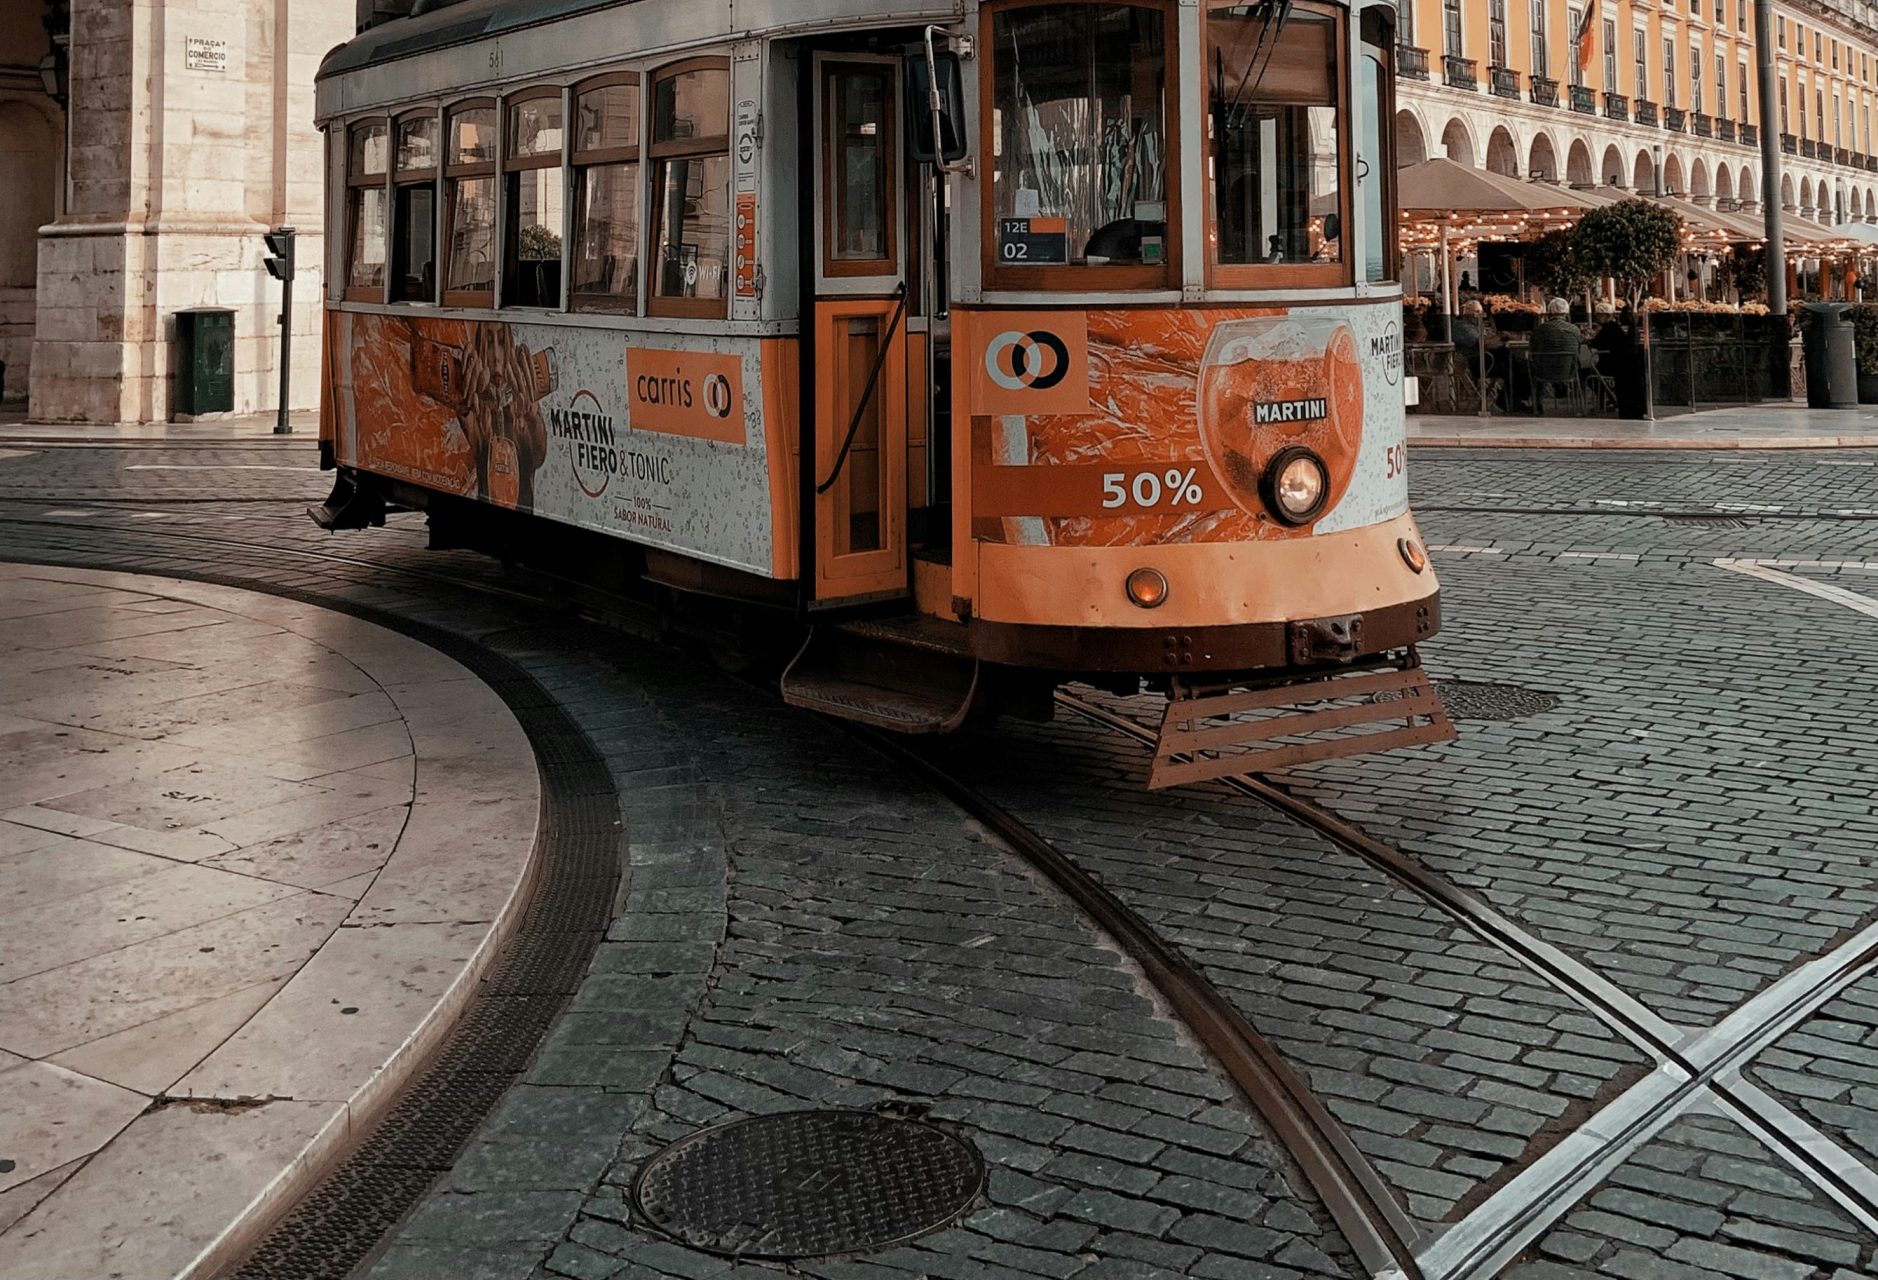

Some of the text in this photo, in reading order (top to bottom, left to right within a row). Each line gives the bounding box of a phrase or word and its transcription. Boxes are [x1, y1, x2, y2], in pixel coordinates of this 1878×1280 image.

[194, 39, 221, 48] PRAÇA
[489, 49, 504, 68] 561
[1005, 222, 1028, 233] 12E
[1003, 243, 1028, 259] 02
[637, 366, 693, 408] carris
[1256, 399, 1326, 423] MARTINI
[550, 408, 615, 446] MARTINI
[578, 442, 618, 475] FIERO
[628, 451, 671, 485] TONIC
[1102, 467, 1203, 508] 50%
[633, 495, 652, 511] 100%
[614, 507, 672, 533] SABOR NATURAL
